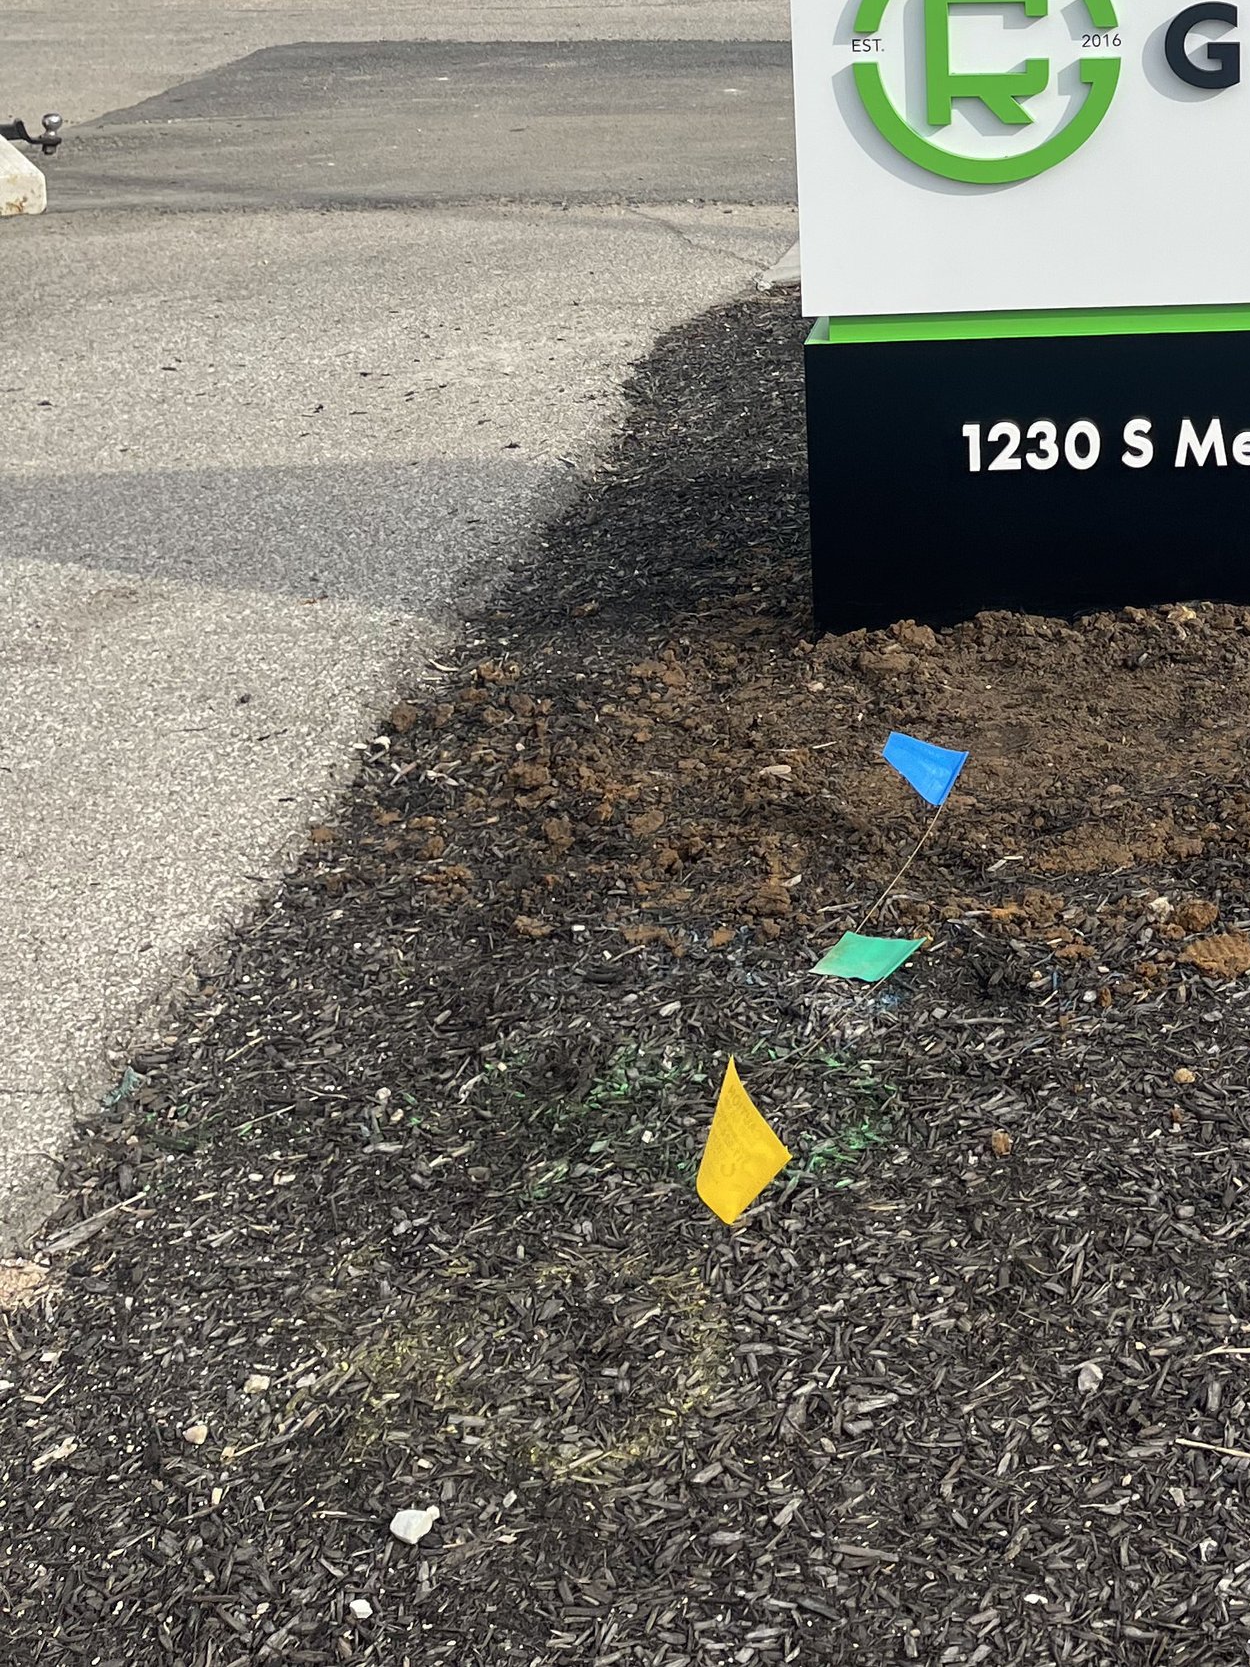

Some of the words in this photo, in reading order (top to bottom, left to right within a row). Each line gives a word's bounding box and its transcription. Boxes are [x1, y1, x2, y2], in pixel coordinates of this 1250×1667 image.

[852, 39, 885, 52] EST.
[1082, 34, 1121, 47] 2016
[963, 421, 1100, 471] 1230
[1122, 419, 1153, 467] S
